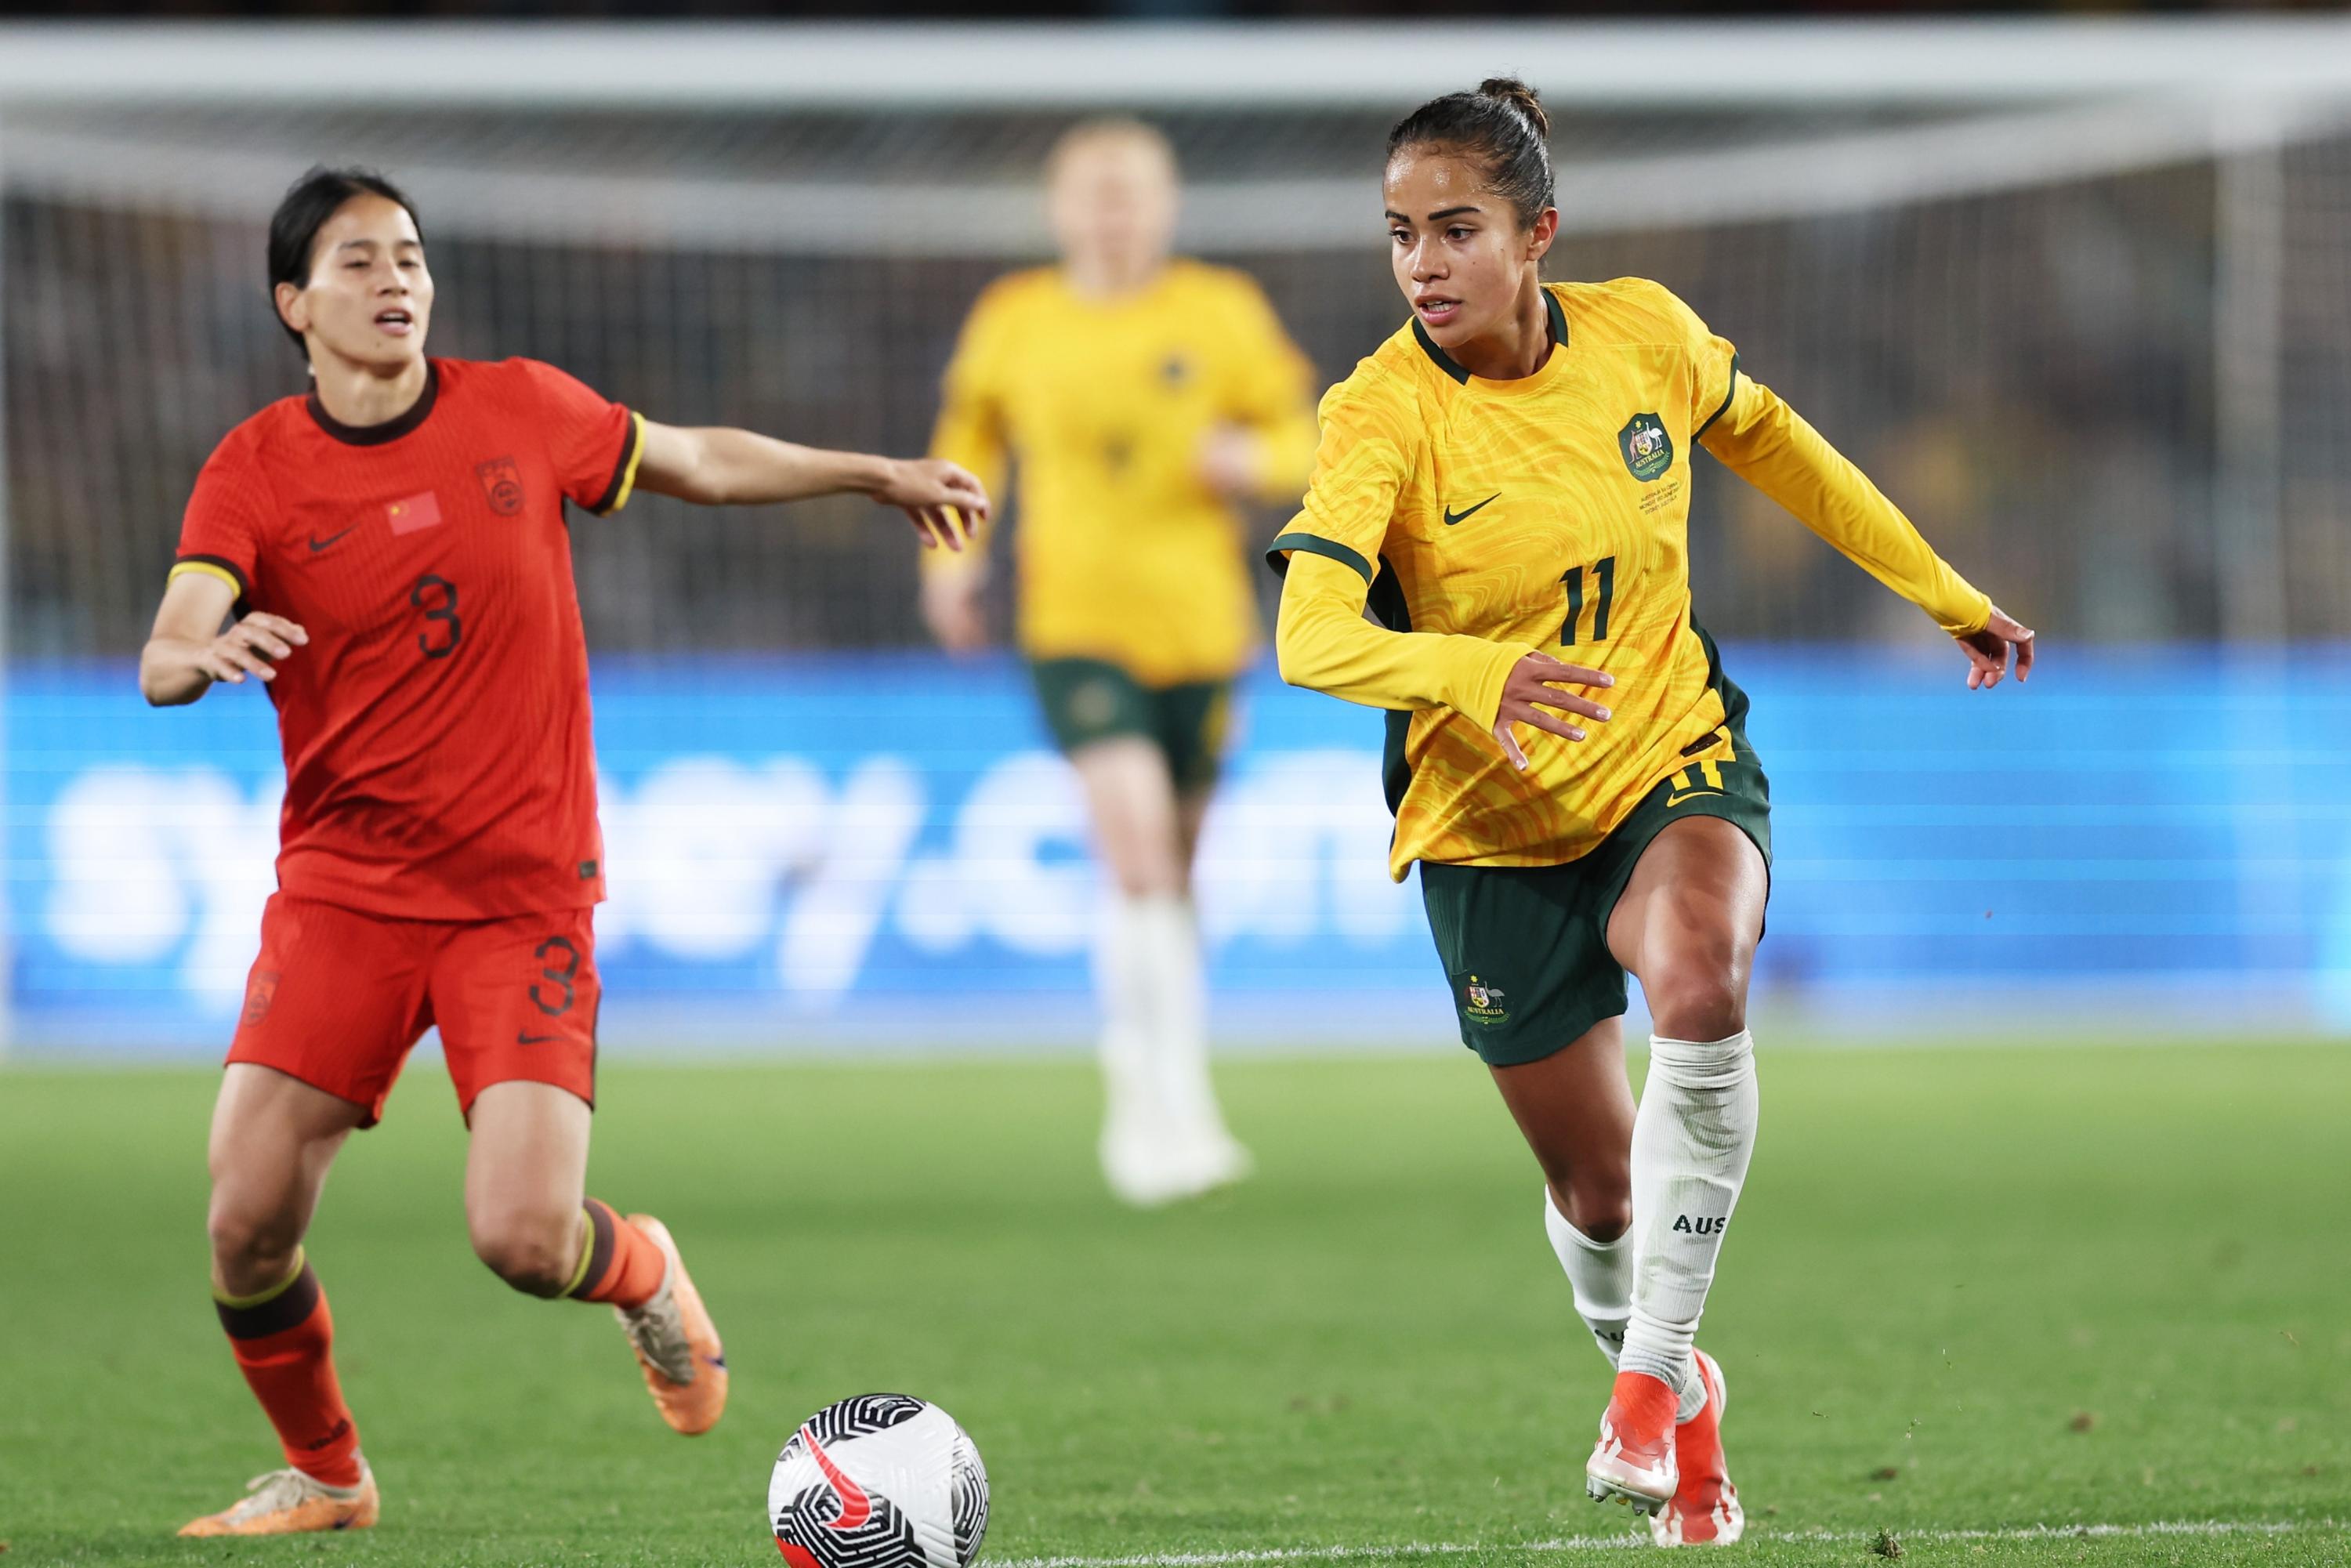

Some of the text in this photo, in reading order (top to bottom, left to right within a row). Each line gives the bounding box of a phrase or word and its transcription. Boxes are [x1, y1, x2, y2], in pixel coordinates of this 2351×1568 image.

[1636, 449, 1665, 469] AUSTRALIA
[411, 574, 461, 659] 3
[1558, 556, 1615, 646] 11
[529, 936, 579, 1016] 3
[1673, 1215, 1726, 1234] AUS
